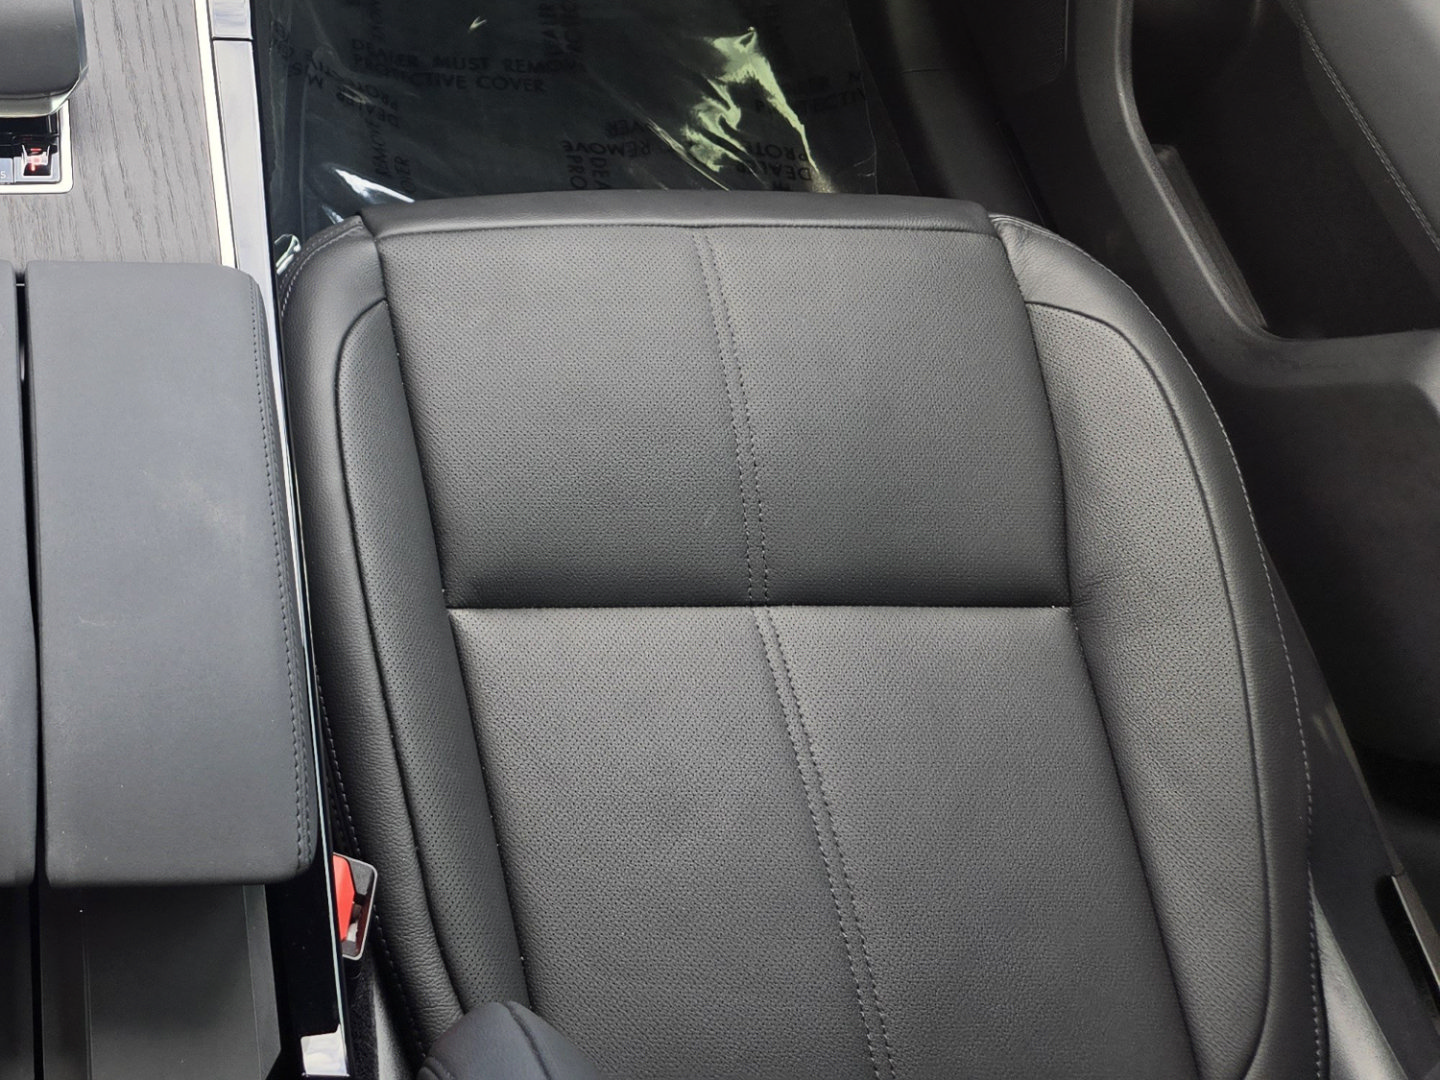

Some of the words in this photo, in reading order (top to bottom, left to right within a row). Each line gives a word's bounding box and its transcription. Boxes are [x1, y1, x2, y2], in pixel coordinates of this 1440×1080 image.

[433, 55, 490, 71] MUST
[475, 75, 547, 93] COVER
[558, 139, 652, 159] REMOVE
